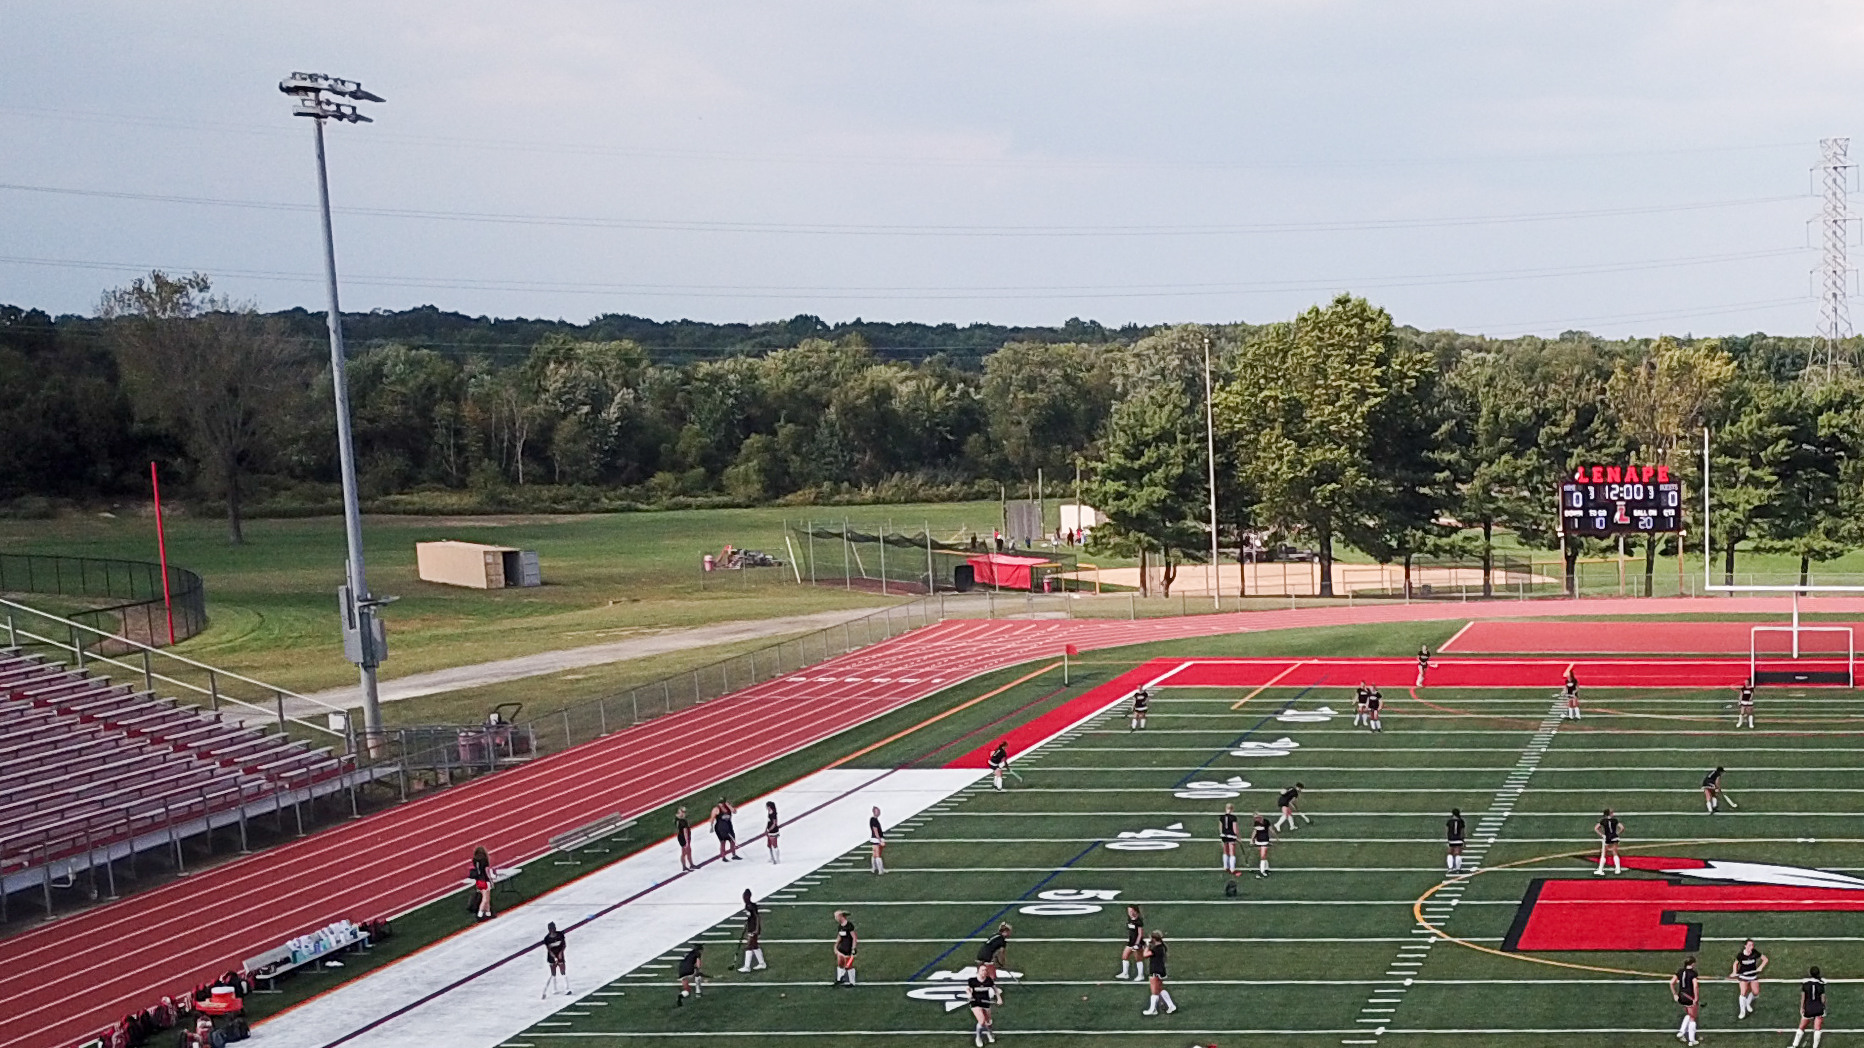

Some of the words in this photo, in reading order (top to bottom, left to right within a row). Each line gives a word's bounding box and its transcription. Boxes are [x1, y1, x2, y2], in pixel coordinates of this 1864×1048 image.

[1578, 466, 1669, 483] LENAPE
[1573, 492, 1583, 508] 0
[1605, 484, 1643, 500] 12:00
[1668, 491, 1678, 507] 0
[1638, 516, 1653, 529] 20
[1019, 889, 1122, 916] 50
